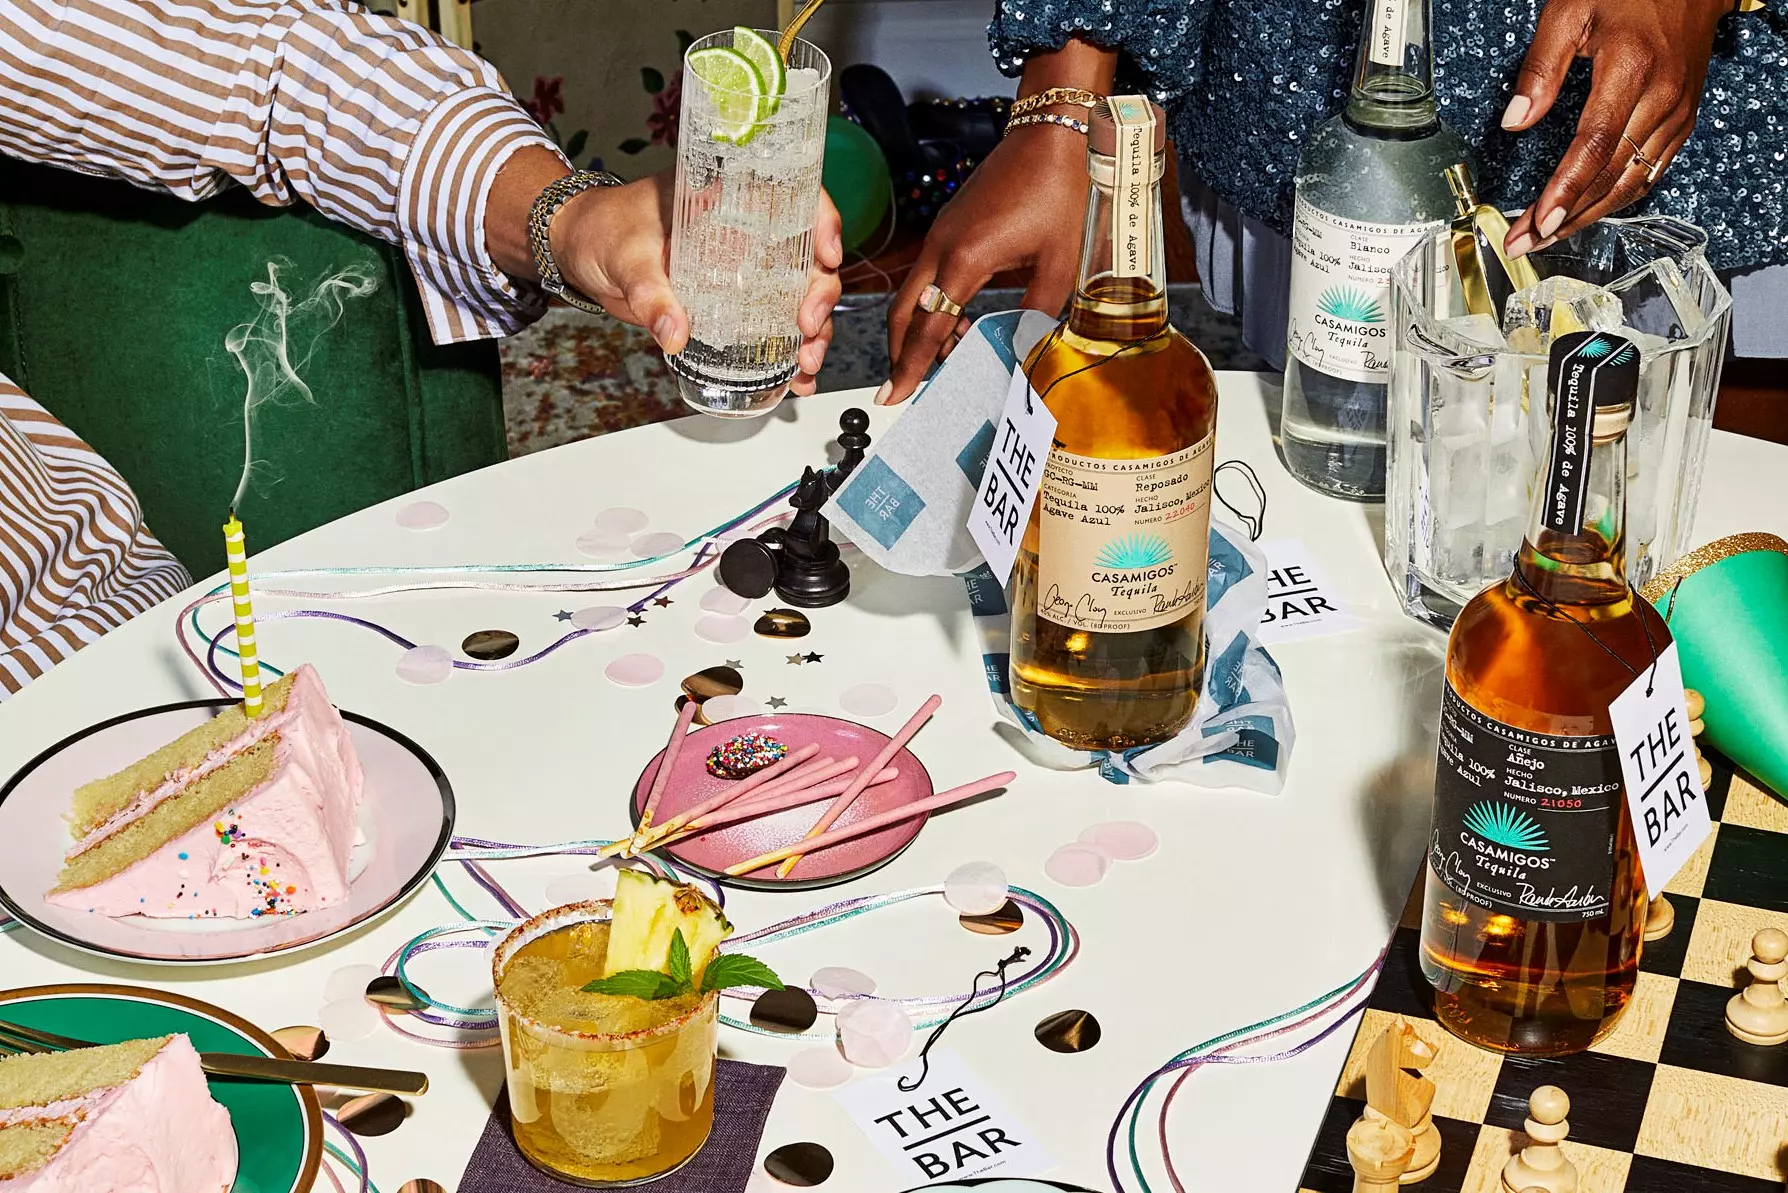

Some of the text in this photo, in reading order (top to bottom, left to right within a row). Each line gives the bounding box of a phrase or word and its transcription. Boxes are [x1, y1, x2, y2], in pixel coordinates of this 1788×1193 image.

[1382, 6, 1394, 58] de Agave
[1126, 126, 1142, 271] Tequila 100% de Agave
[1332, 219, 1387, 234] CASAMIGOS
[1320, 251, 1341, 266] 100%
[1350, 242, 1390, 254] Blanco
[1310, 258, 1330, 274] Azul
[1314, 314, 1386, 338] CASAMIGOS
[1328, 332, 1368, 348] Tequila
[1002, 417, 1036, 490] THE
[1555, 363, 1585, 526] Tequila 100% de Agave
[1112, 458, 1174, 472] CASAMIGOS
[1179, 452, 1190, 462] DE
[1135, 472, 1188, 492] Reposado
[1136, 473, 1156, 482] CLASE
[1043, 484, 1077, 498] CATEGORIA
[1134, 478, 1211, 514] Jalisco, Mexico
[1135, 494, 1159, 502] HECHO
[984, 472, 1019, 546] BAR
[1043, 491, 1125, 515] Tequila 100%
[1134, 502, 1196, 525] NUMERO 22040
[1042, 504, 1111, 526] Agave Azul
[1092, 565, 1174, 584] CASAMIGOS
[1268, 566, 1312, 588] HE
[1110, 583, 1158, 600] Tequila
[1114, 608, 1146, 616] EXCLUSIVO
[1103, 622, 1130, 630] PROOF)
[1486, 722, 1556, 748] CASAMIGOS
[1563, 740, 1578, 748] DE
[1630, 707, 1682, 782] THE
[1506, 752, 1544, 770] Añejo
[1508, 744, 1531, 756] CLASE
[1457, 765, 1482, 787] Azul
[1469, 758, 1496, 780] 100%
[1506, 767, 1533, 780] HECHO
[1504, 776, 1620, 798] Jalisco, Mexico
[1504, 791, 1582, 808] NUMERO 21050
[1643, 770, 1696, 848] BAR
[1460, 832, 1550, 870] CASAMIGOS
[1476, 855, 1527, 880] Tequila
[1466, 893, 1492, 908] PROOF)
[1476, 882, 1512, 898] EXCLUSIVO
[874, 1087, 980, 1138] THE
[912, 1128, 1022, 1180] BAR
